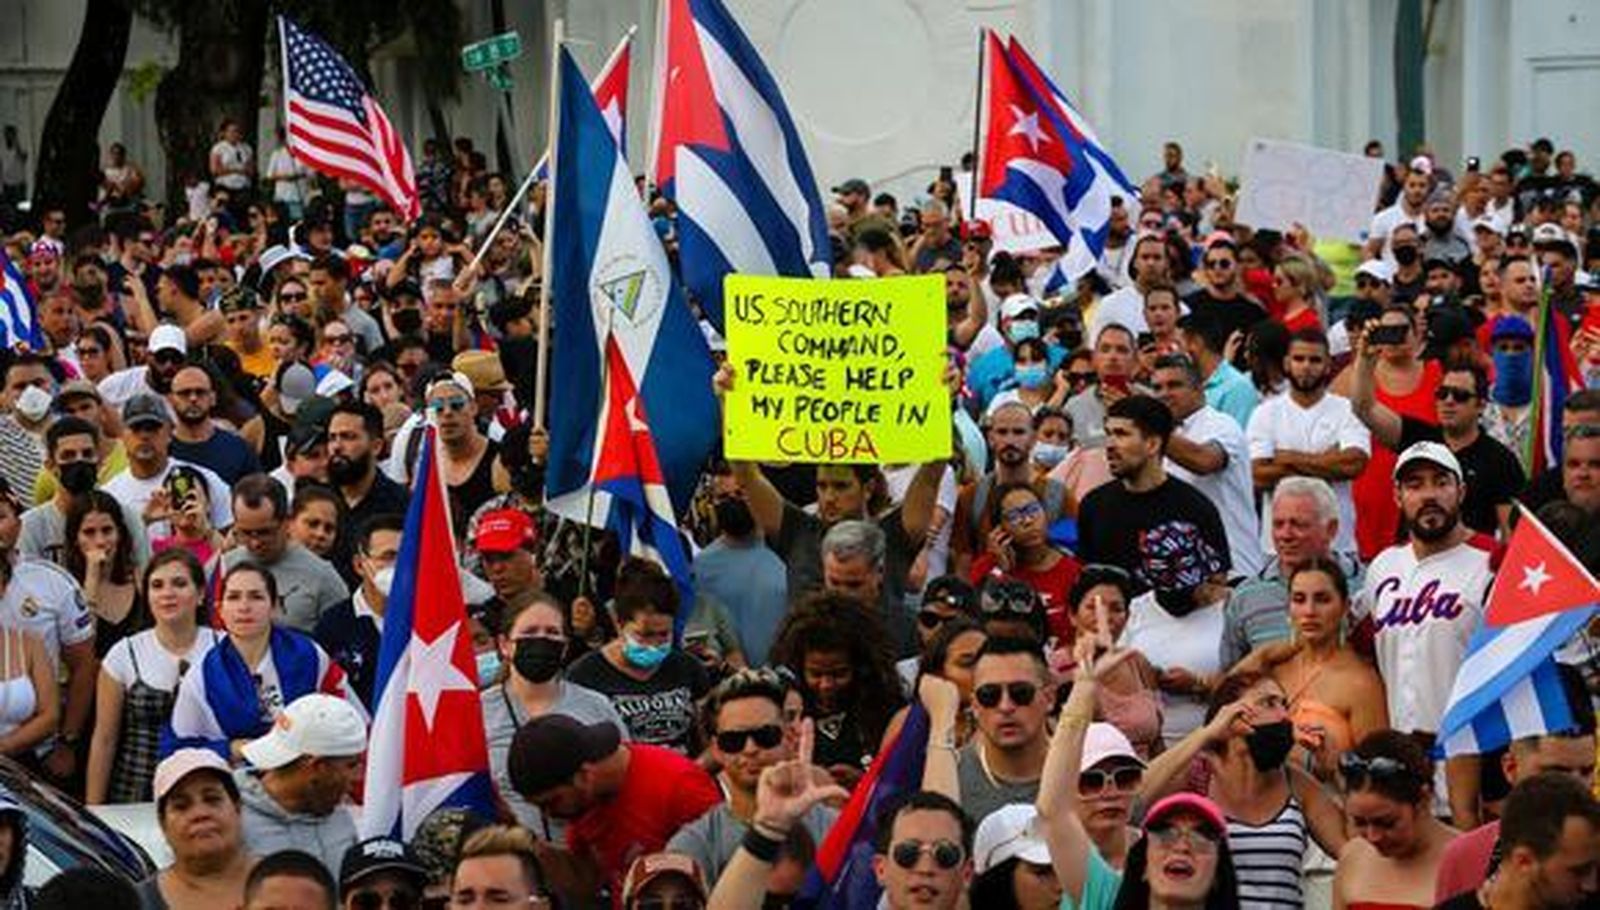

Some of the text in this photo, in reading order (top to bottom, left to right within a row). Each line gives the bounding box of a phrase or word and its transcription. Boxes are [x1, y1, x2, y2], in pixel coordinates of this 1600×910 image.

[774, 298, 892, 328] SOUTHERN
[778, 329, 906, 361] COMMAND,
[745, 357, 915, 391] PLEASE HELP
[751, 395, 929, 426] MY PEOPLE IN
[777, 427, 879, 459] CUBA
[1375, 577, 1463, 632] Cuba
[613, 687, 690, 716] ALIFORN
